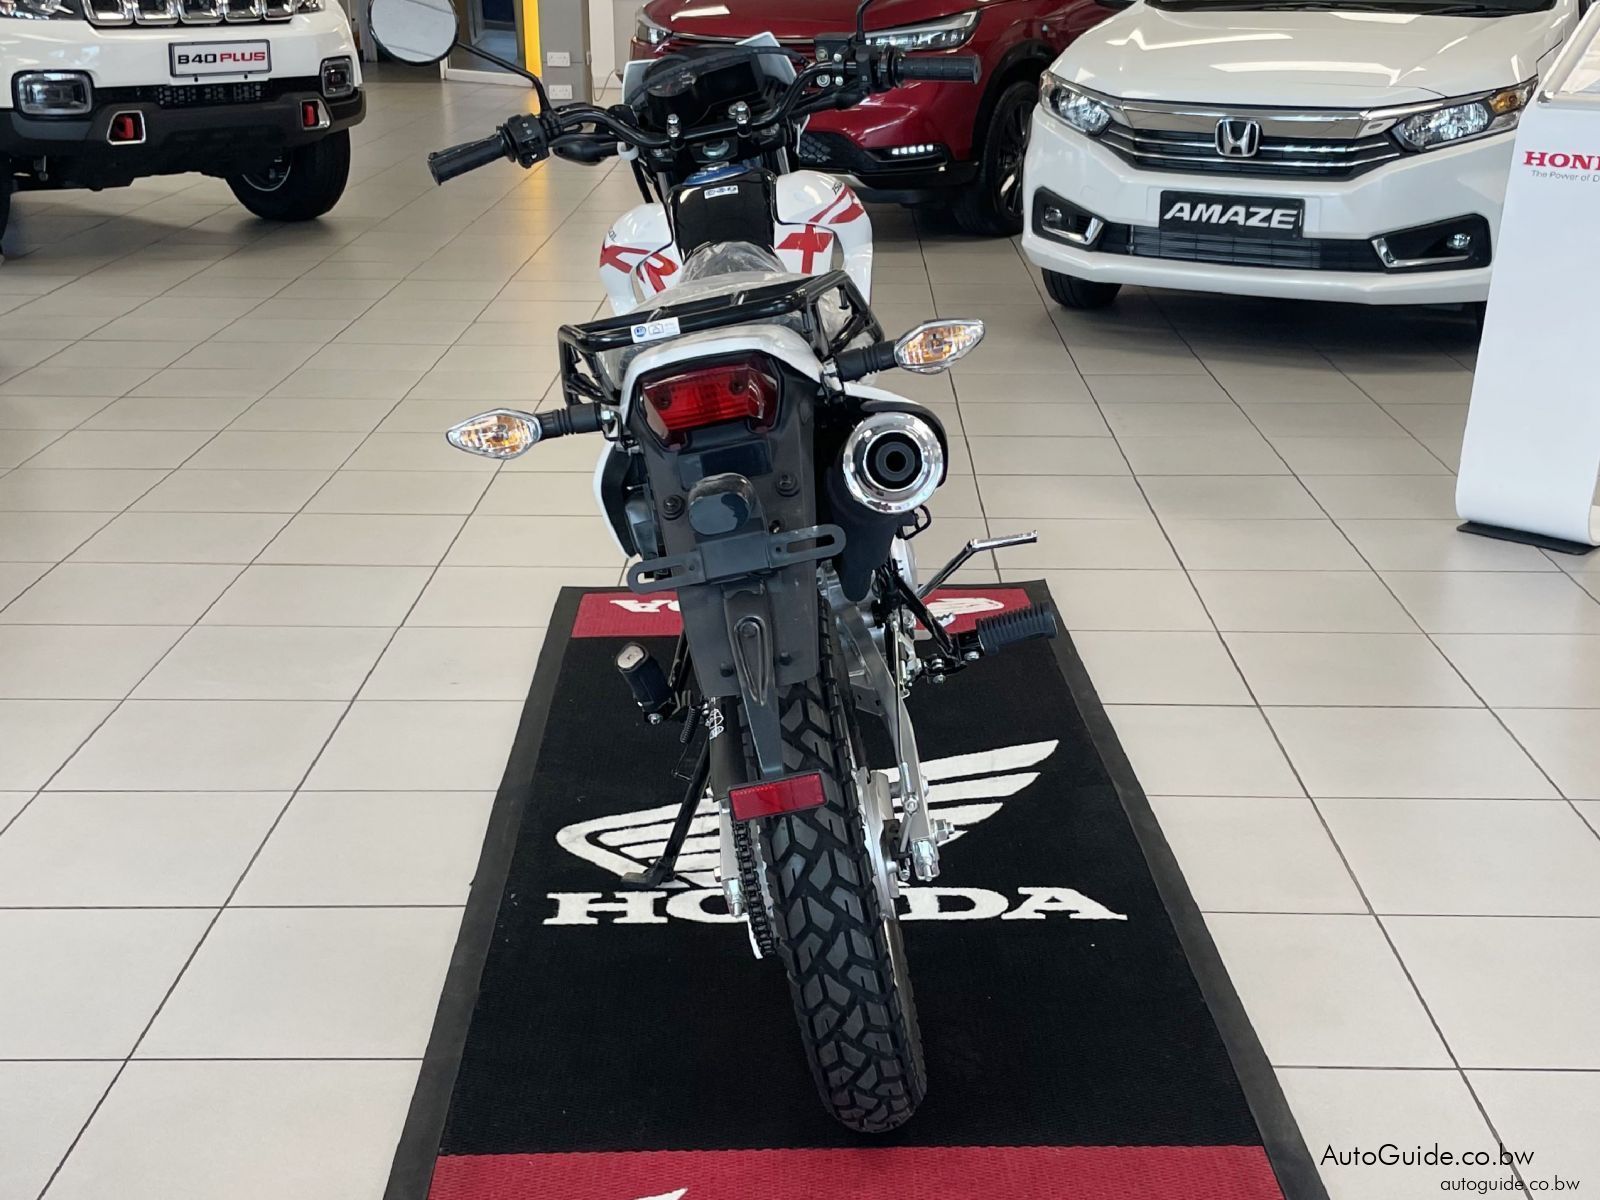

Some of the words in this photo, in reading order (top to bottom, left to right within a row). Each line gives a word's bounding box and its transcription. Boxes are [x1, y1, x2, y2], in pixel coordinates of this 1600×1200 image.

[177, 53, 217, 65] B40
[219, 51, 266, 62] PLUS
[1531, 169, 1548, 178] The
[1549, 171, 1578, 181] Power
[1163, 202, 1297, 230] AMAZE
[543, 886, 1129, 925] HODA
